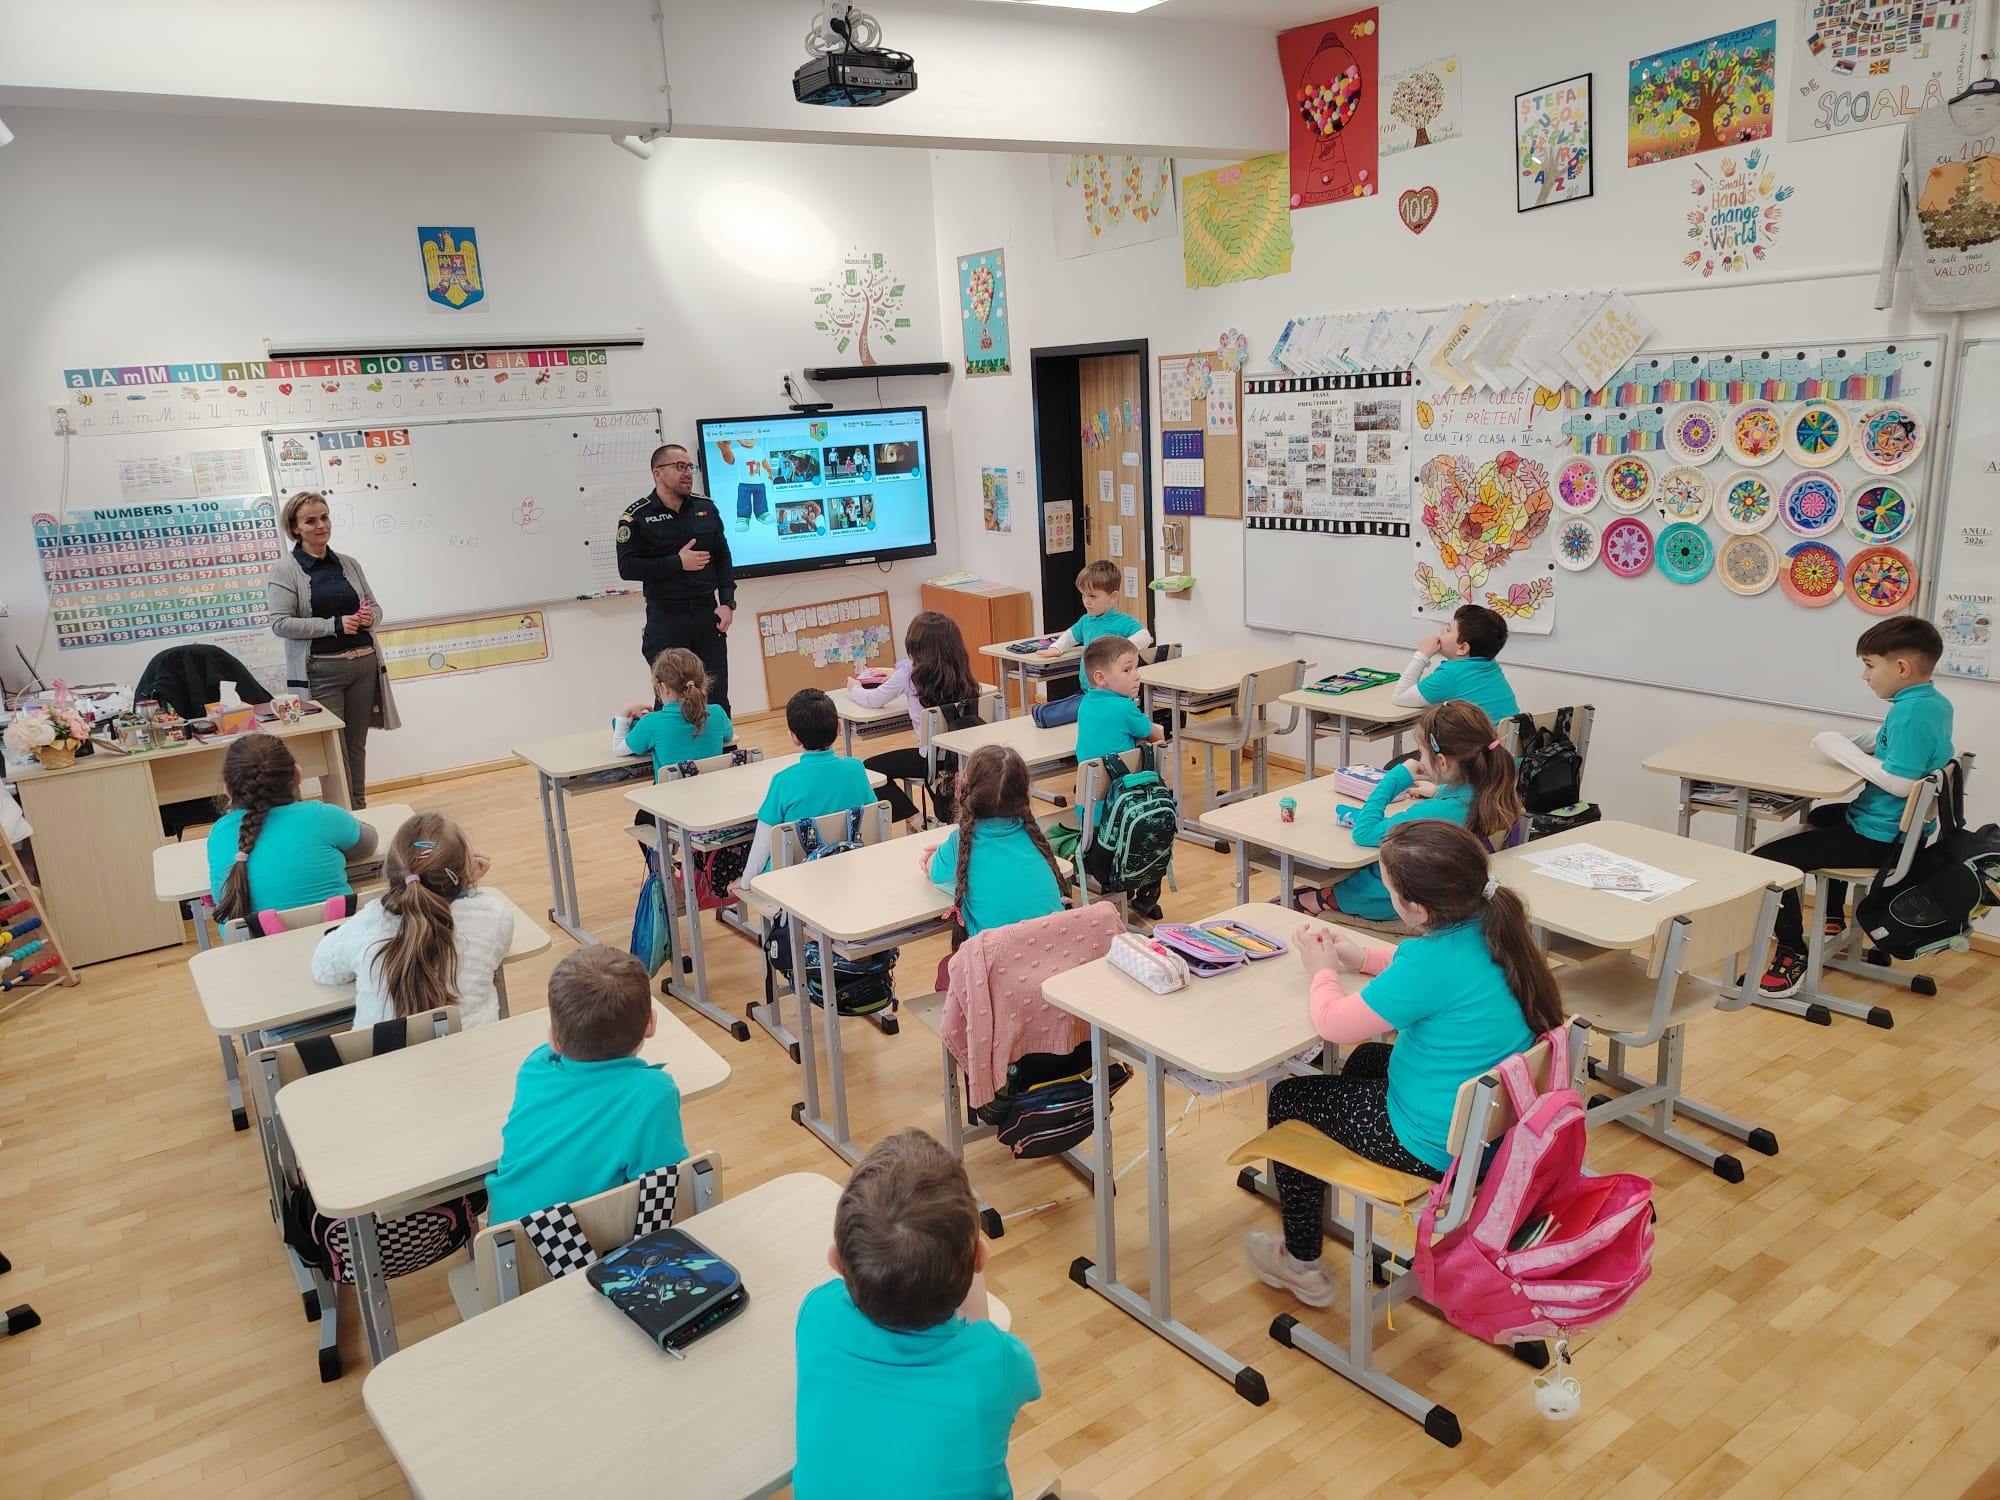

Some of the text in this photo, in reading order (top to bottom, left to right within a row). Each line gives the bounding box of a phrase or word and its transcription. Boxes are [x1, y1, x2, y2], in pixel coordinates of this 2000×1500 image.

[1800, 78, 1820, 96] DE
[1960, 136, 1996, 160] 100
[1719, 173, 1746, 190] Small
[1402, 195, 1433, 223] 100
[1712, 186, 1756, 210] Hands
[1711, 206, 1760, 226] change
[1710, 220, 1756, 250] World
[1934, 262, 1992, 277] VALOROS
[72, 373, 85, 386] a
[100, 370, 116, 386] A
[124, 373, 142, 386] m
[149, 367, 168, 384] M
[178, 371, 190, 382] u
[202, 364, 216, 381] U
[228, 368, 239, 380] n
[251, 363, 266, 378] N
[324, 364, 332, 376] r
[343, 359, 358, 374] R
[366, 362, 378, 374] o
[386, 356, 402, 372] O
[408, 359, 418, 372] e
[432, 354, 444, 370] E
[452, 358, 462, 369] c
[472, 353, 486, 368] C
[553, 350, 564, 366] L
[572, 354, 586, 366] ce
[589, 352, 606, 364] Ce
[1431, 393, 1476, 406] SUNTEM
[328, 430, 406, 449] t T s S
[1424, 433, 1446, 444] CLASA
[1478, 434, 1506, 445] CLASA
[94, 502, 220, 520] NUMBERS 1-100
[257, 508, 271, 518] 10
[41, 518, 273, 547] 11 12 13 14 15 16 17 18 19 20
[69, 546, 86, 556] 22
[94, 544, 111, 554] 23
[119, 542, 135, 552] 24
[143, 539, 159, 549] 25
[167, 537, 184, 547] 26
[190, 535, 207, 545] 27
[214, 533, 230, 543] 28
[237, 531, 253, 541] 29
[259, 529, 276, 539] 30
[1960, 527, 1992, 536] ANUL:
[1964, 536, 1984, 546] 2026
[74, 568, 91, 578] 42
[99, 566, 115, 576] 43
[124, 563, 140, 574] 44
[147, 561, 164, 571] 45
[171, 559, 188, 569] 46
[195, 556, 211, 566] 47
[218, 554, 234, 564] 48
[241, 552, 257, 562] 49
[262, 550, 279, 560] 50
[51, 564, 260, 593] 51 52 53 54 55 56 57 58 59
[58, 590, 265, 620] 71 72 73 74 75 76 77 78 79
[1946, 594, 1996, 604] ANOTIMP:
[60, 602, 267, 633] 81 82 83 84 85 86 87 88 89
[63, 614, 269, 646] 91 92 93 94 95 96 97 98 99
